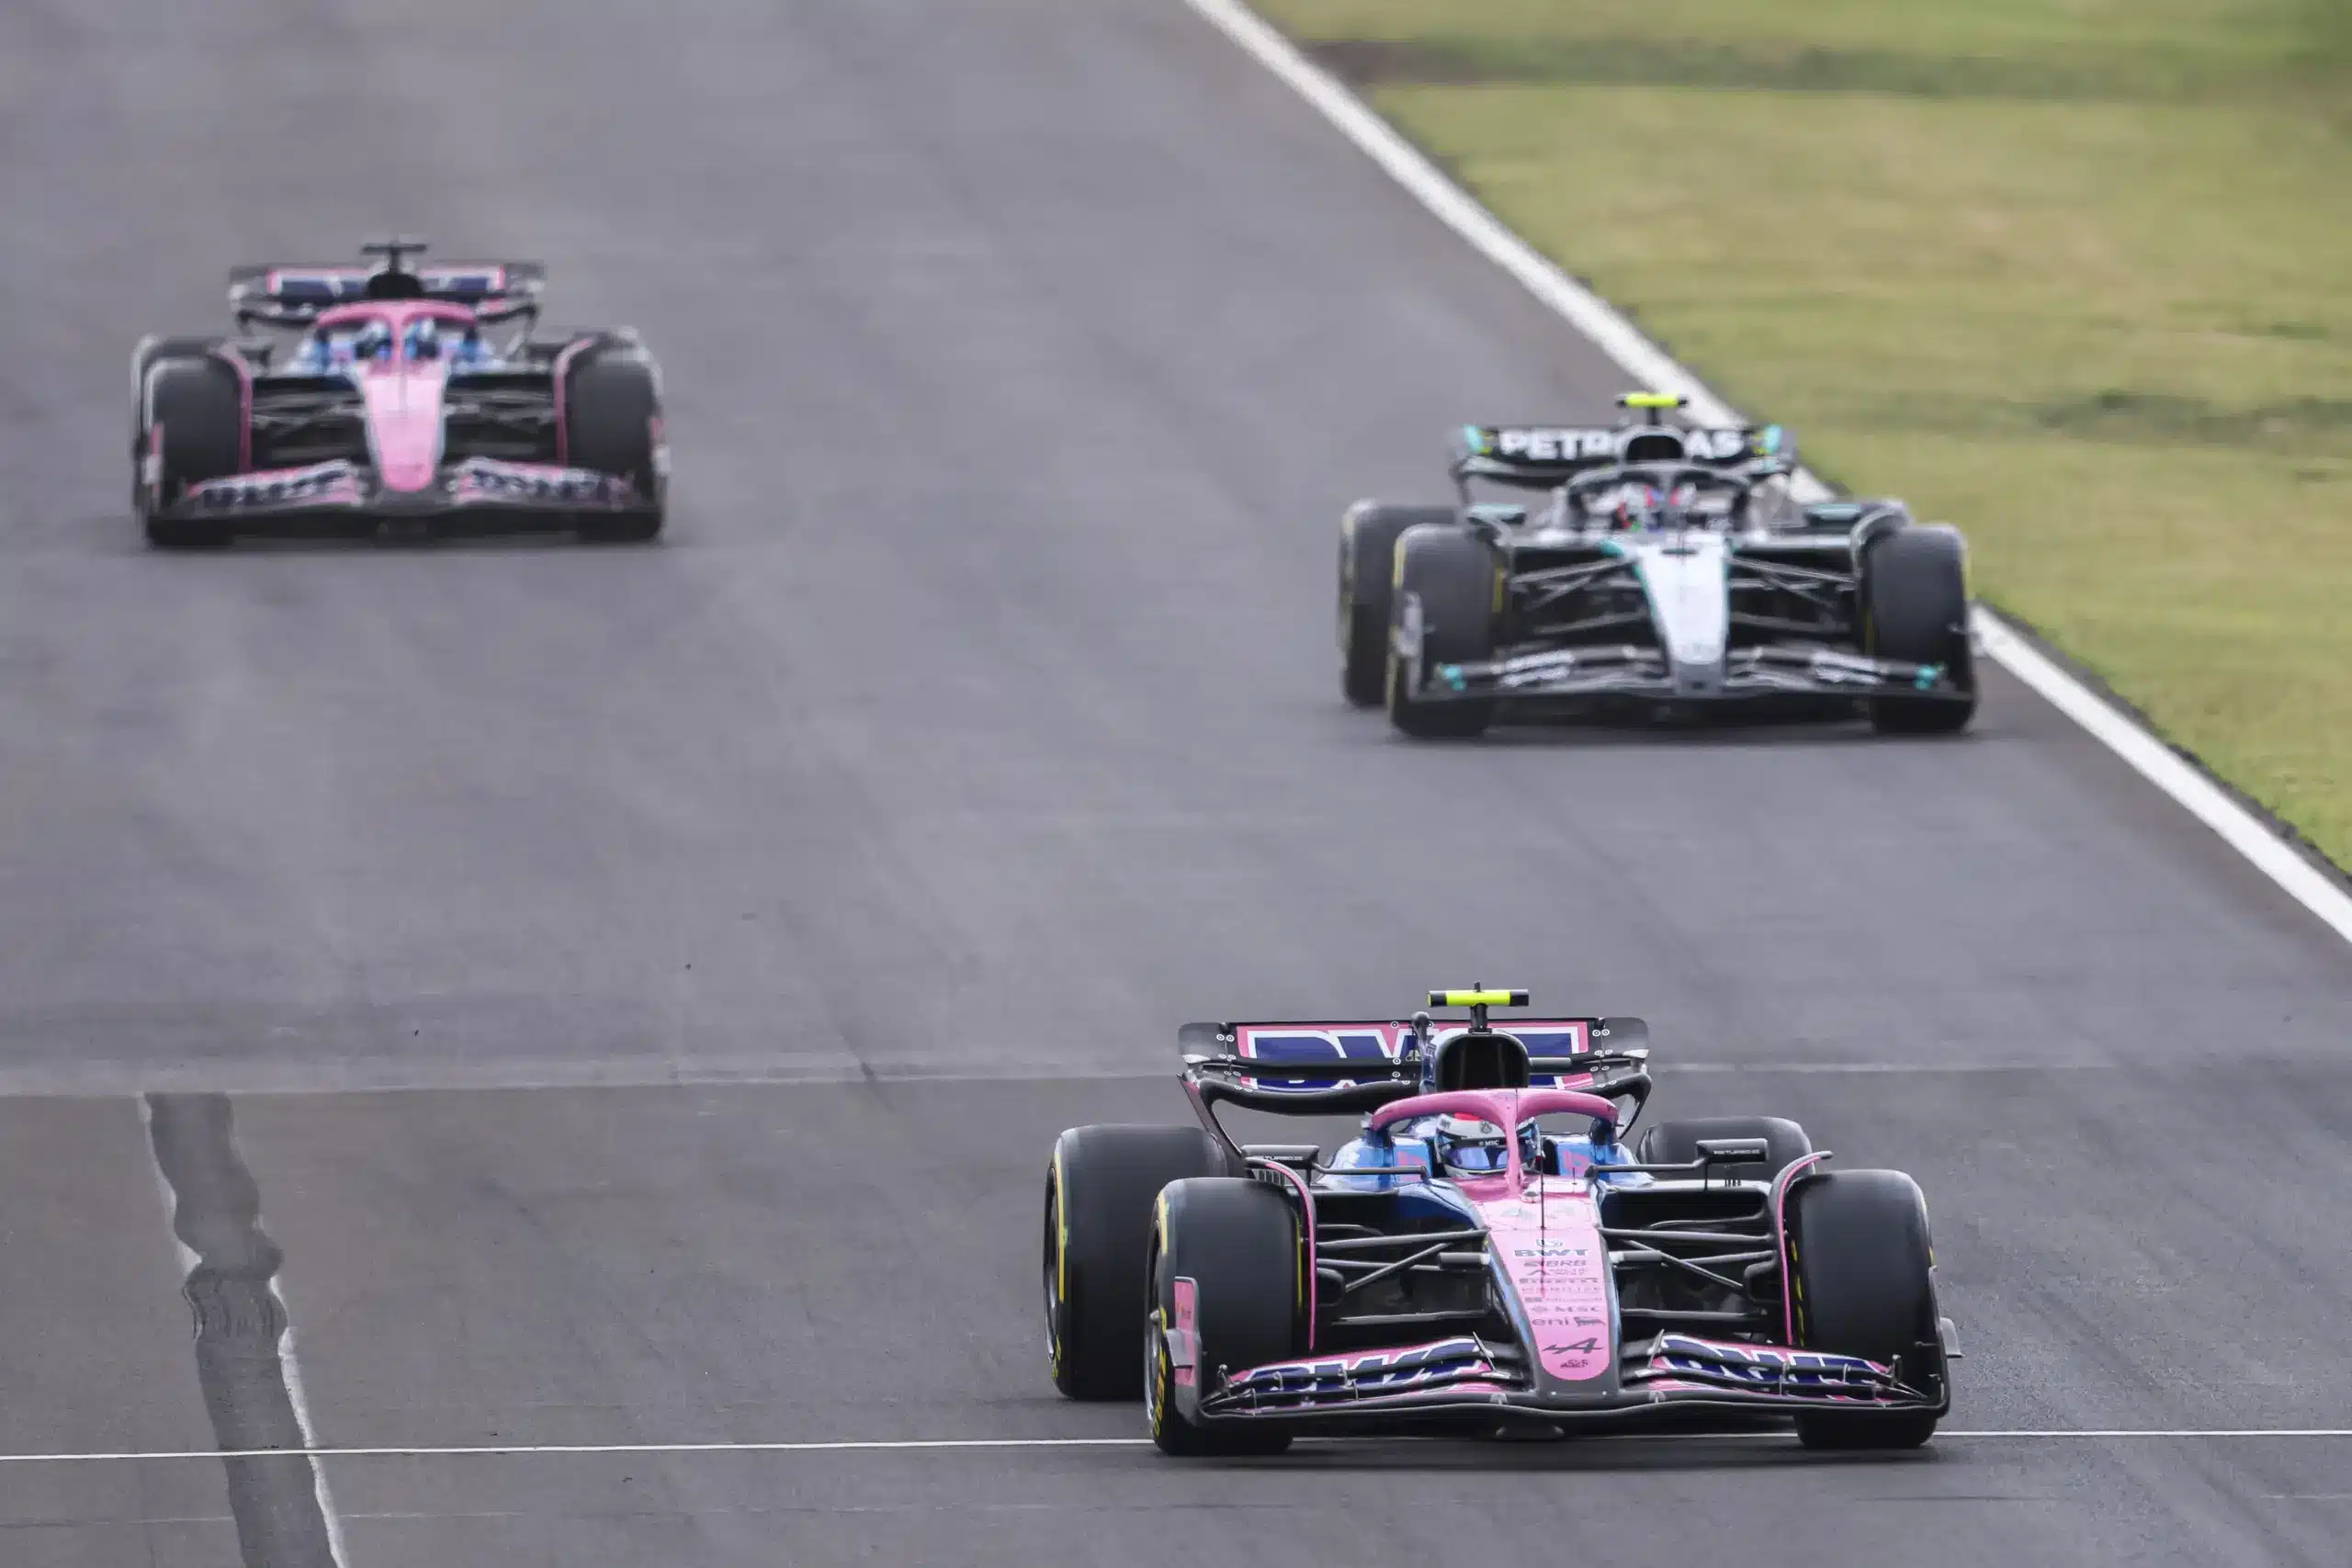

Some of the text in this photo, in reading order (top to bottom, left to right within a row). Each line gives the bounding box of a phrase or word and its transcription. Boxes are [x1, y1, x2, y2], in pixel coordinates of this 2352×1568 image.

[1498, 427, 1742, 460] PETRAS
[1514, 1249, 1589, 1258] BWT
[1532, 1317, 1569, 1325] eni
